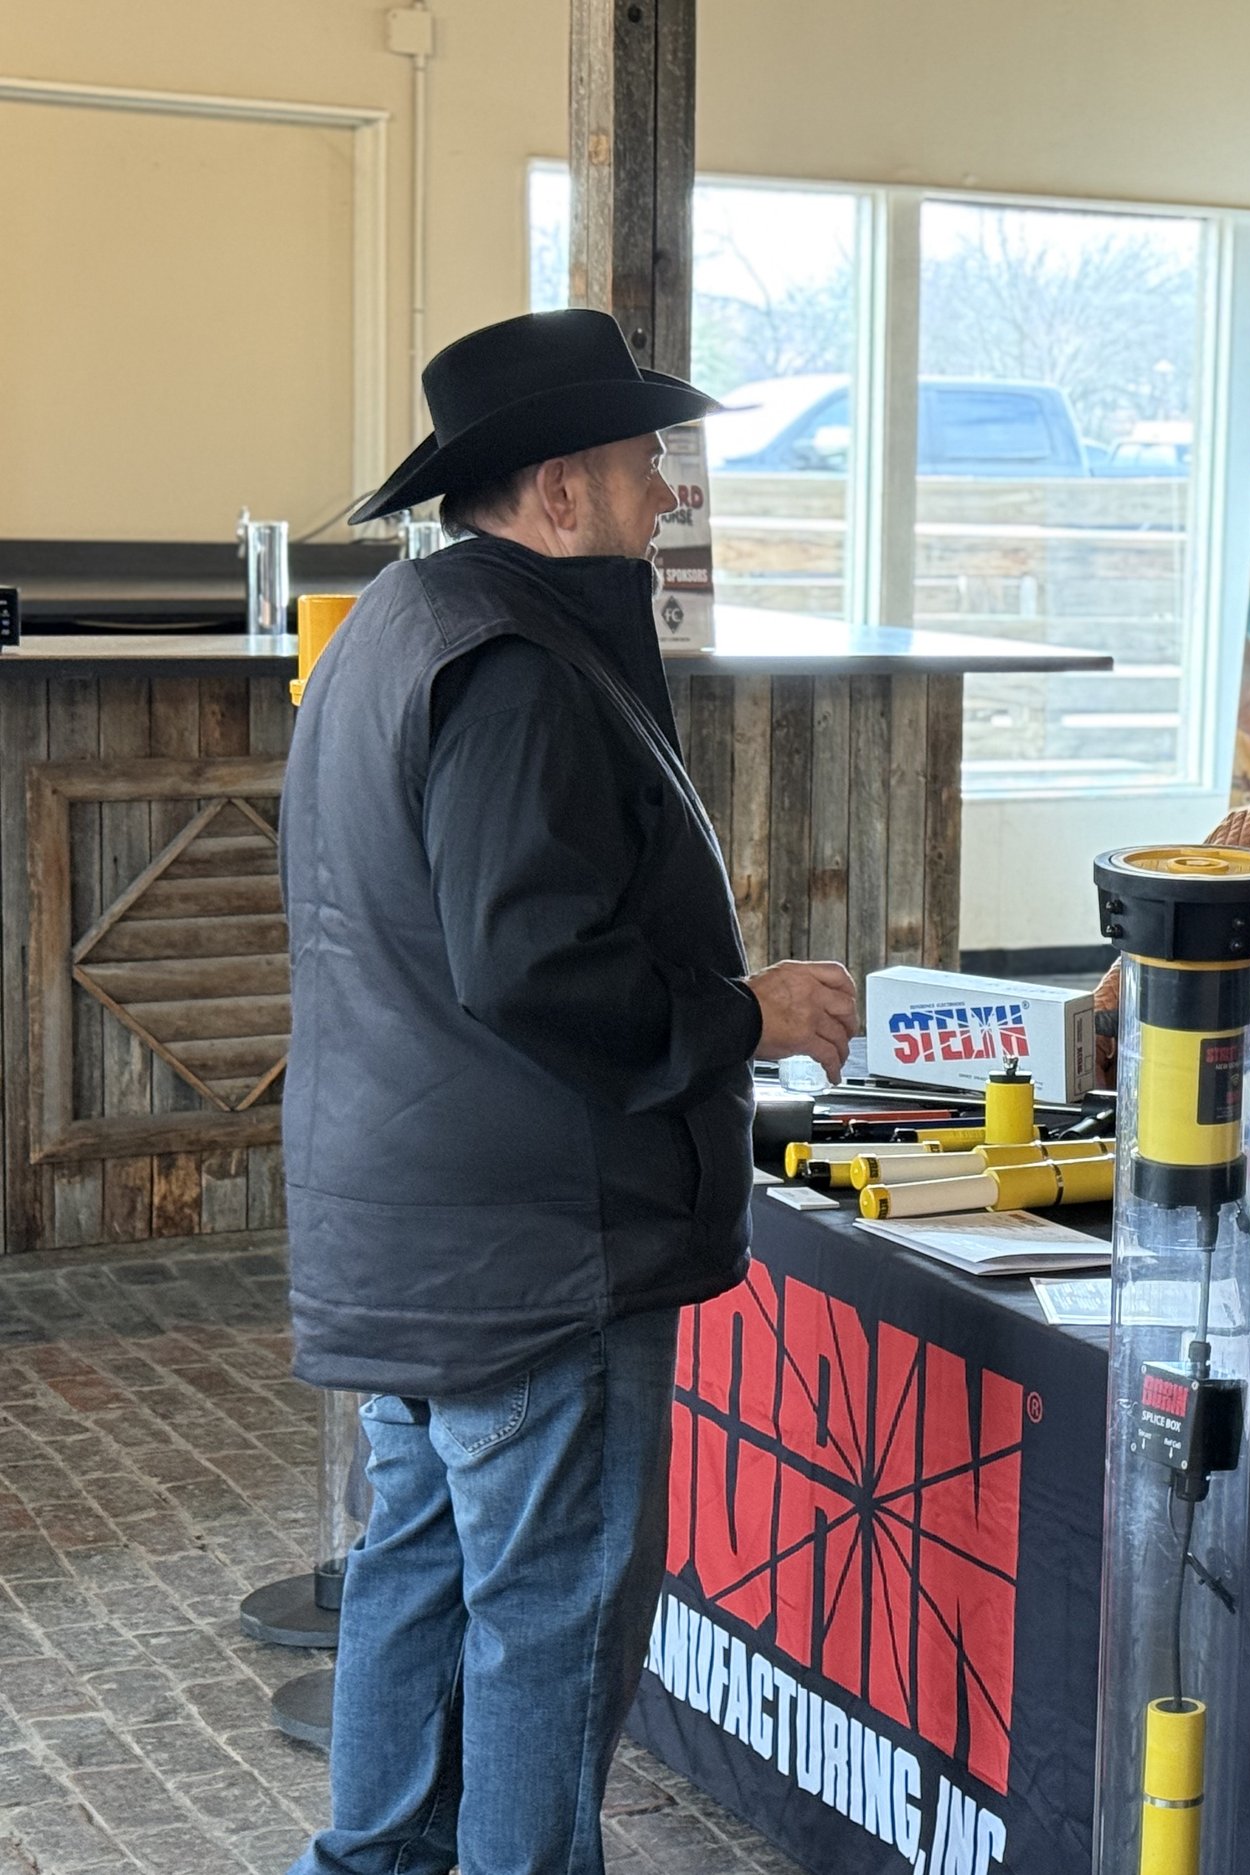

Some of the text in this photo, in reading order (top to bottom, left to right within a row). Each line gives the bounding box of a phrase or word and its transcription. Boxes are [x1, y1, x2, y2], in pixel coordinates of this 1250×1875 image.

[667, 568, 708, 583] SPONSORS
[1142, 1410, 1182, 1433] SPLICE BOX
[643, 1592, 926, 1875] ANUFACTURING,
